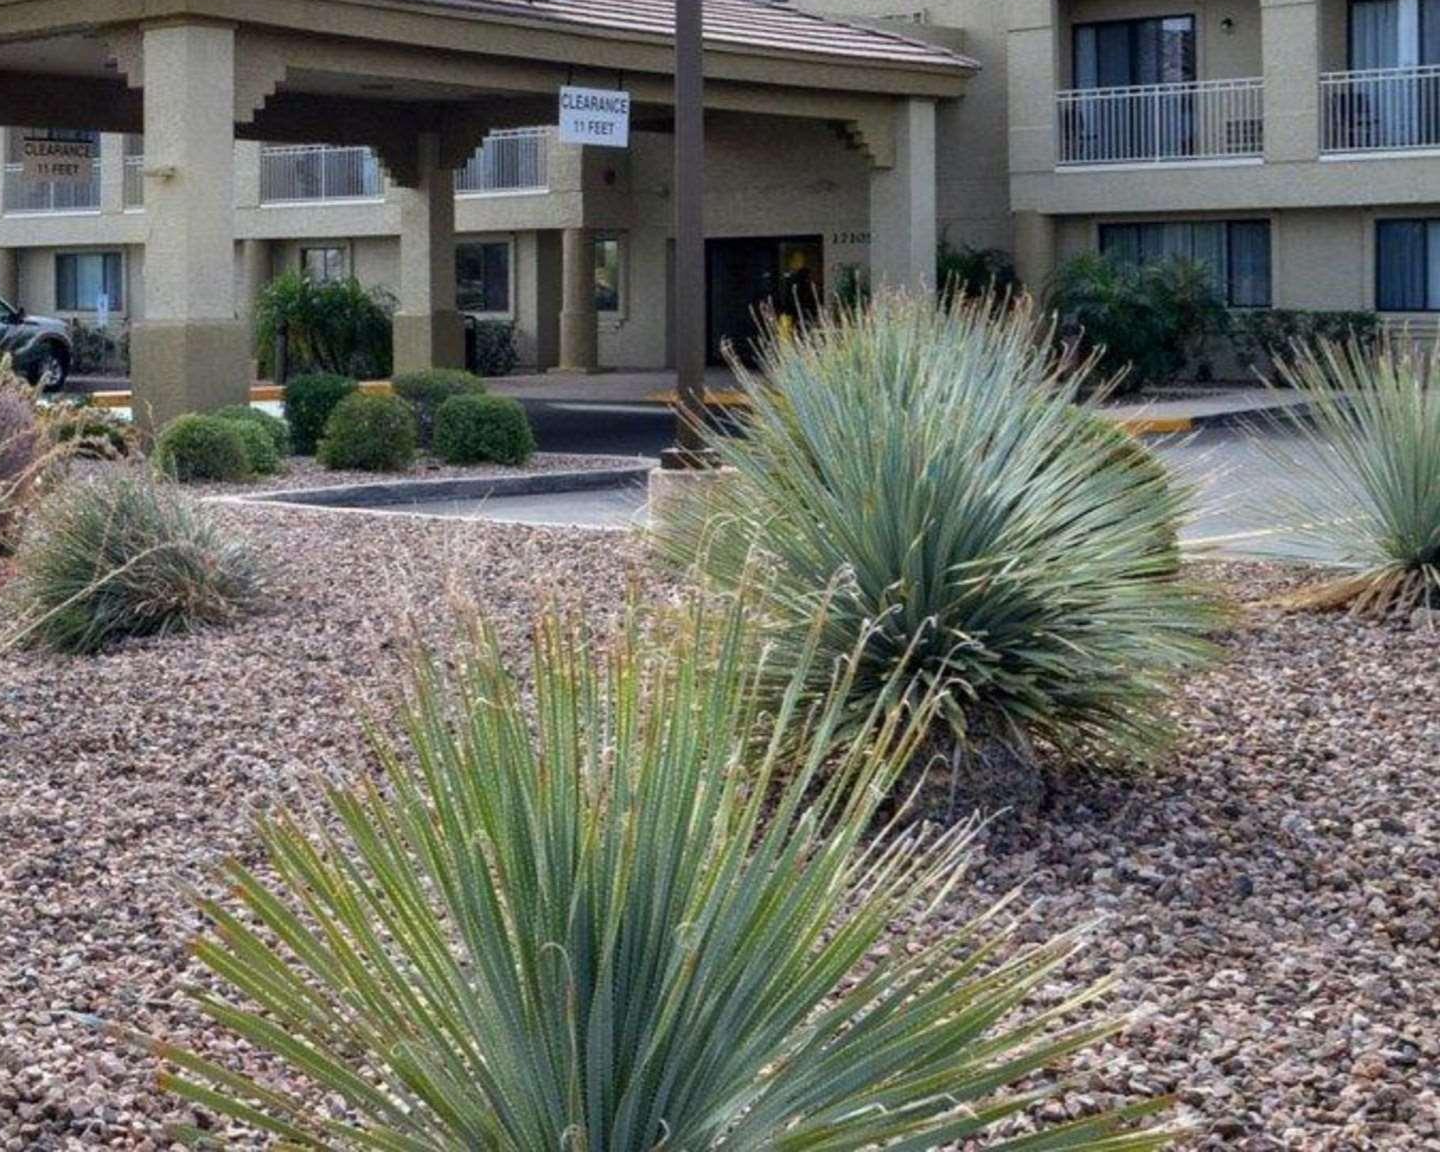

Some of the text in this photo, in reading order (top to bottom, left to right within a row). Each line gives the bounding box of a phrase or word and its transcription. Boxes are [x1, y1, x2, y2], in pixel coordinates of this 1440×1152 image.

[563, 94, 627, 114] CLEARANCE
[574, 120, 614, 135] 11 FEET
[24, 142, 93, 158] CLEARANCE
[52, 164, 79, 176] FEET
